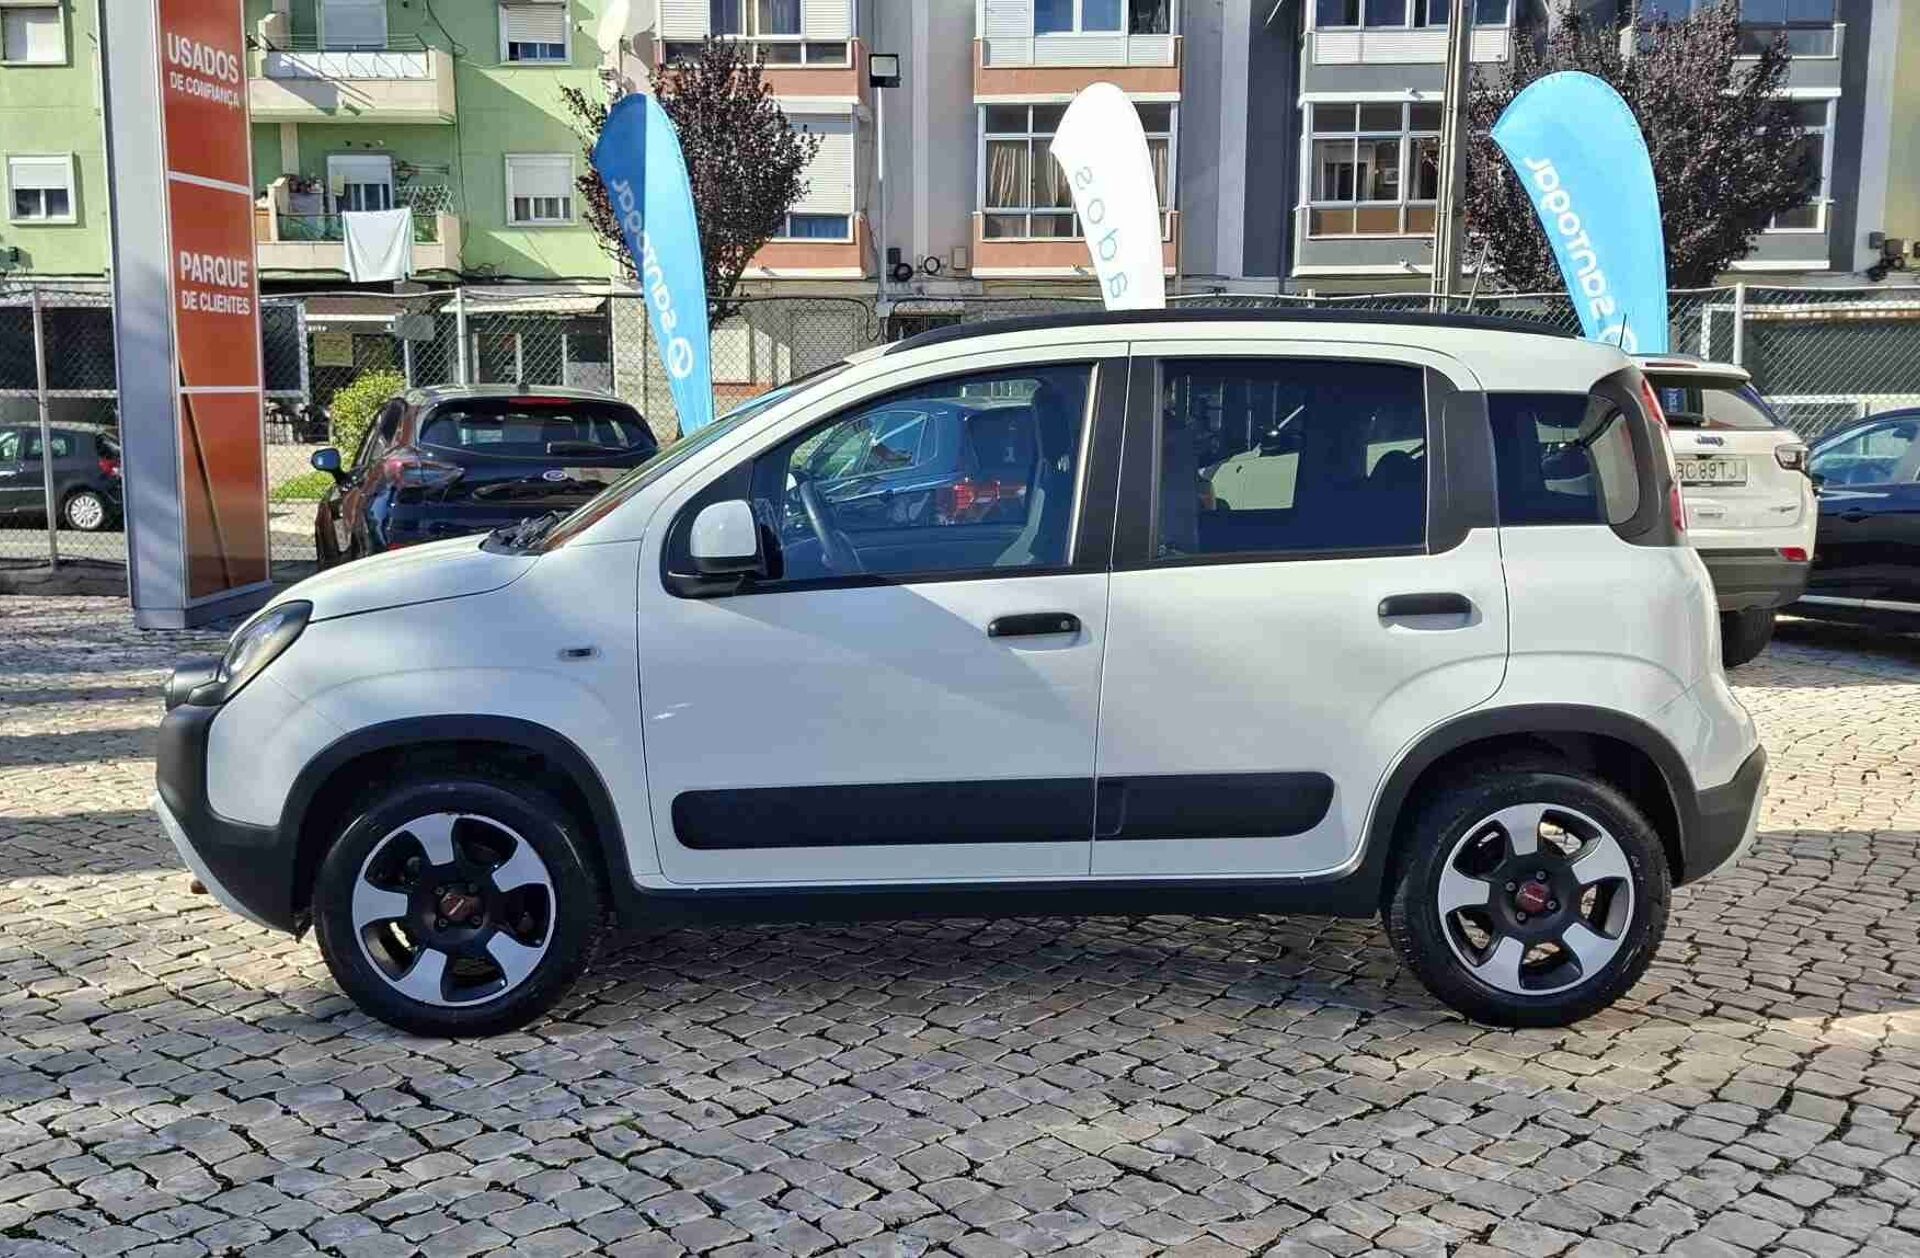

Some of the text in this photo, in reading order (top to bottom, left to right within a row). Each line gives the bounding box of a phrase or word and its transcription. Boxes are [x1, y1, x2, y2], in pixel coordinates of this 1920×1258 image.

[167, 32, 239, 84] USADOS
[169, 71, 185, 91] DE
[180, 250, 249, 289] PARQUE
[181, 290, 251, 316] DE CLIENTES
